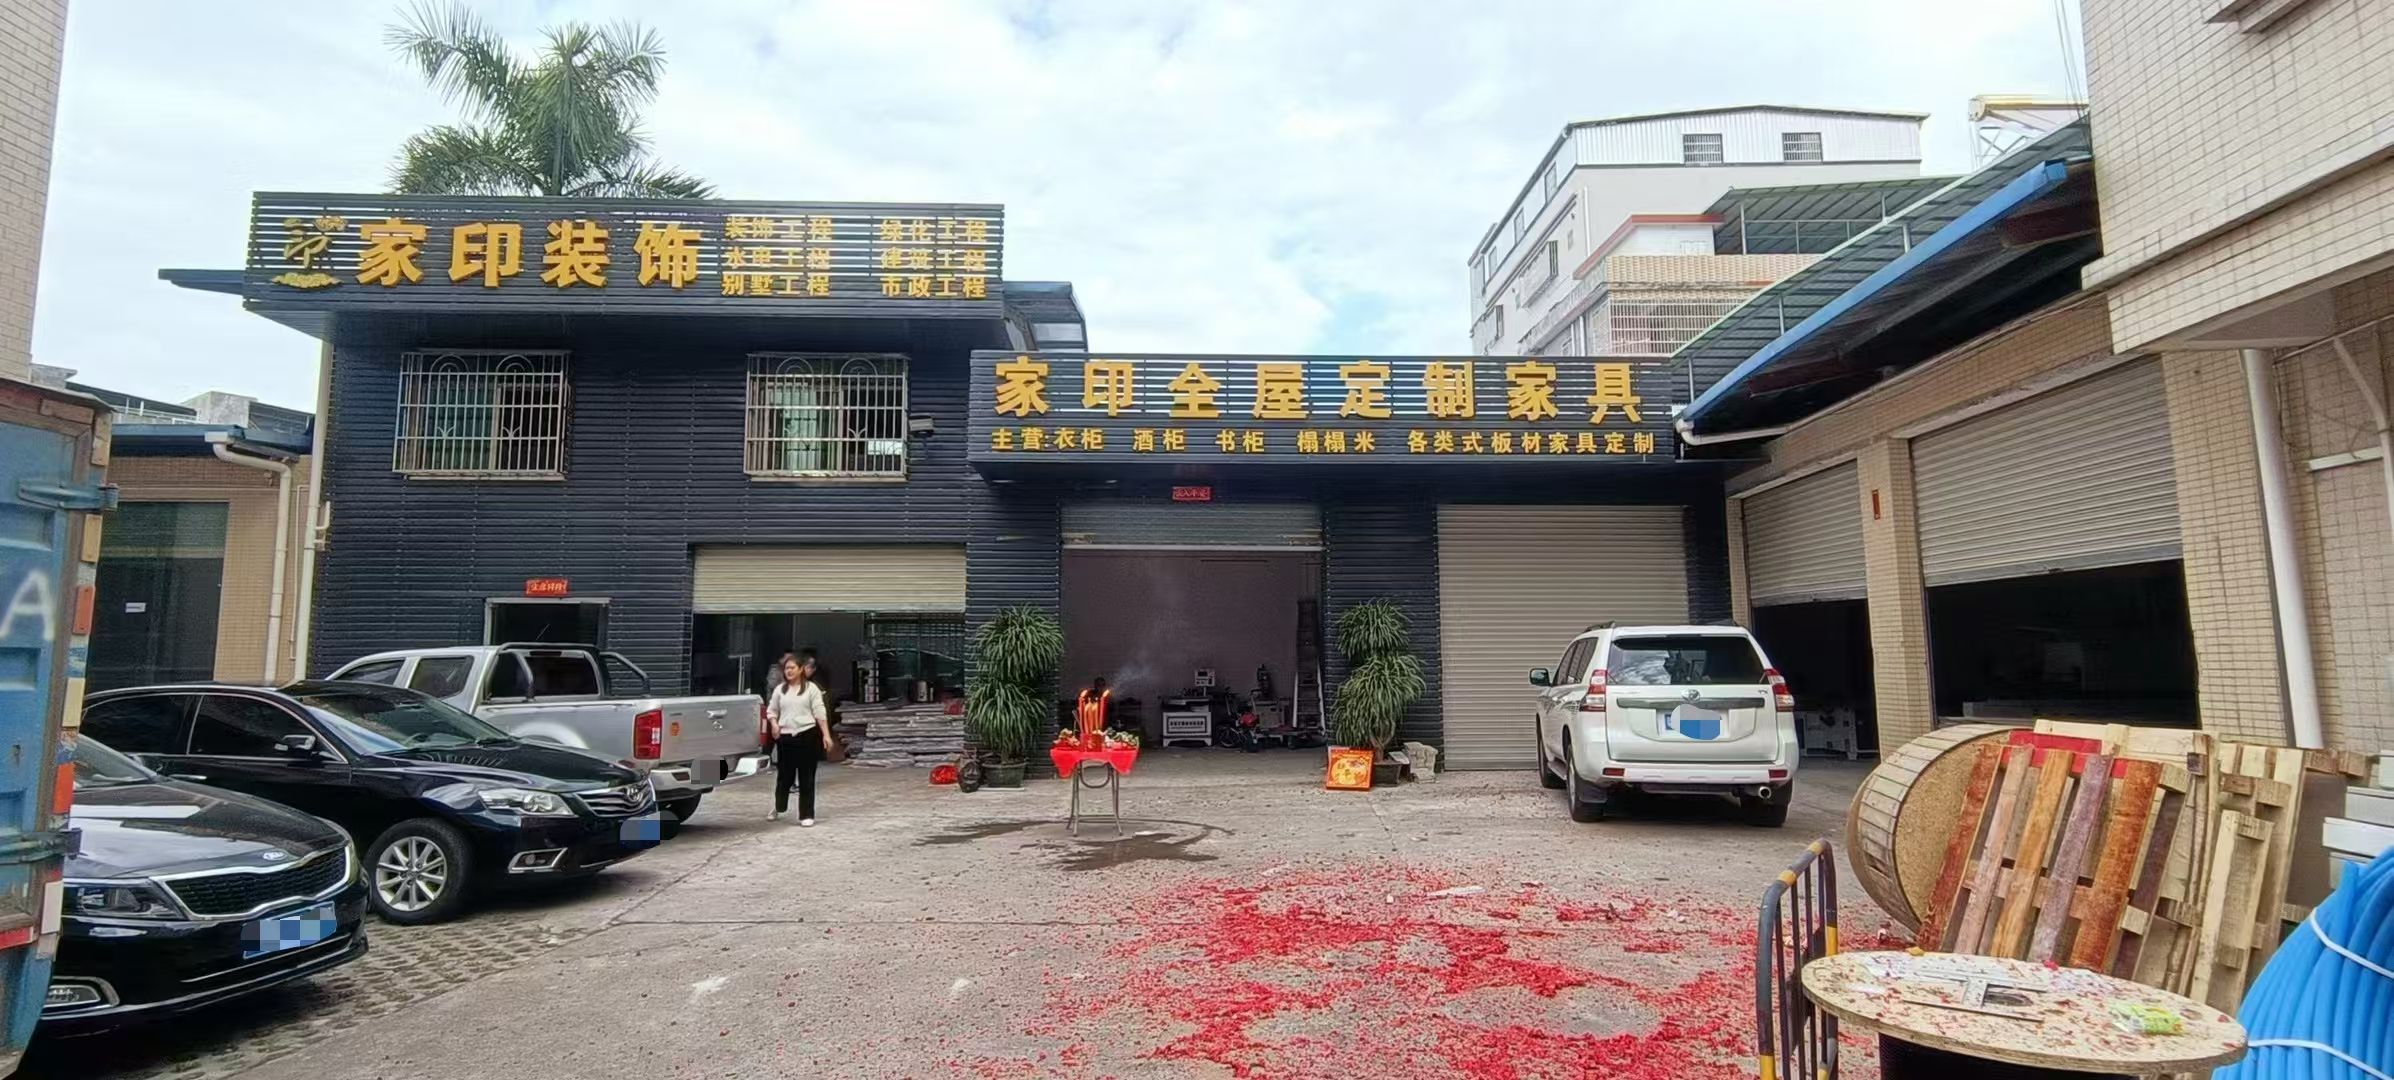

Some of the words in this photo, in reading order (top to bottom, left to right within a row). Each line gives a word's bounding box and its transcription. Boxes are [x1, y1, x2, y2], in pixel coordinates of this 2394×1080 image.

[725, 216, 833, 240] 装饰工程
[880, 219, 987, 242] 绿化工程
[356, 218, 701, 289] 家印装饰
[725, 246, 831, 269] 水电工程
[881, 247, 986, 271] 建筑工程
[721, 274, 831, 296] 别墅工程
[880, 276, 986, 298] 市政工程
[994, 356, 1642, 424] 家印全屋定制家具
[1133, 427, 1186, 452] 酒柜
[1215, 429, 1266, 453] 书柜
[1296, 429, 1376, 453] 榻榻米
[1407, 430, 1655, 454] 各类式板材家具定制
